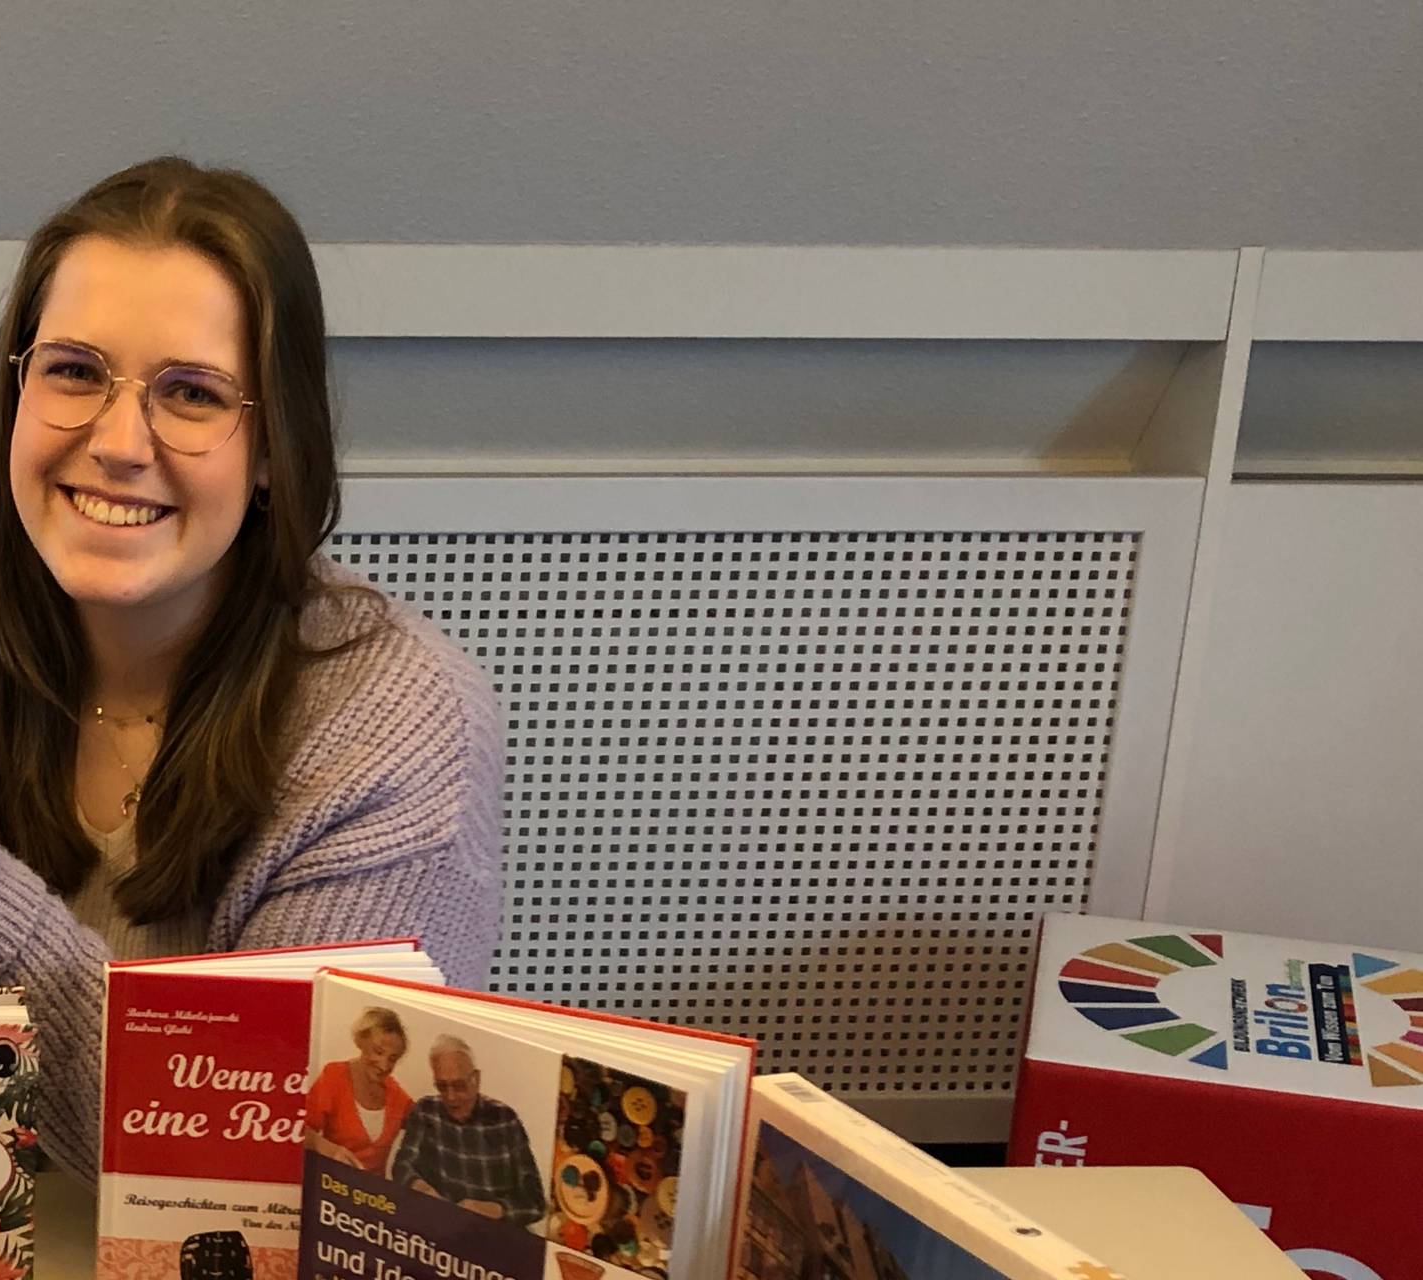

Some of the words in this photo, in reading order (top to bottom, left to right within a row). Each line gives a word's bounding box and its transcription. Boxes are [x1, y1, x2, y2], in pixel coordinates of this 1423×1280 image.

[1253, 983, 1312, 1060] Brilon
[167, 1053, 276, 1093] Wenn
[122, 1100, 210, 1138] eine
[222, 1100, 307, 1144] Rei
[123, 1193, 227, 1211] Reisegeschichten
[232, 1204, 259, 1213] zum
[320, 1173, 350, 1197] Das
[352, 1188, 397, 1215] große
[318, 1240, 365, 1276] und
